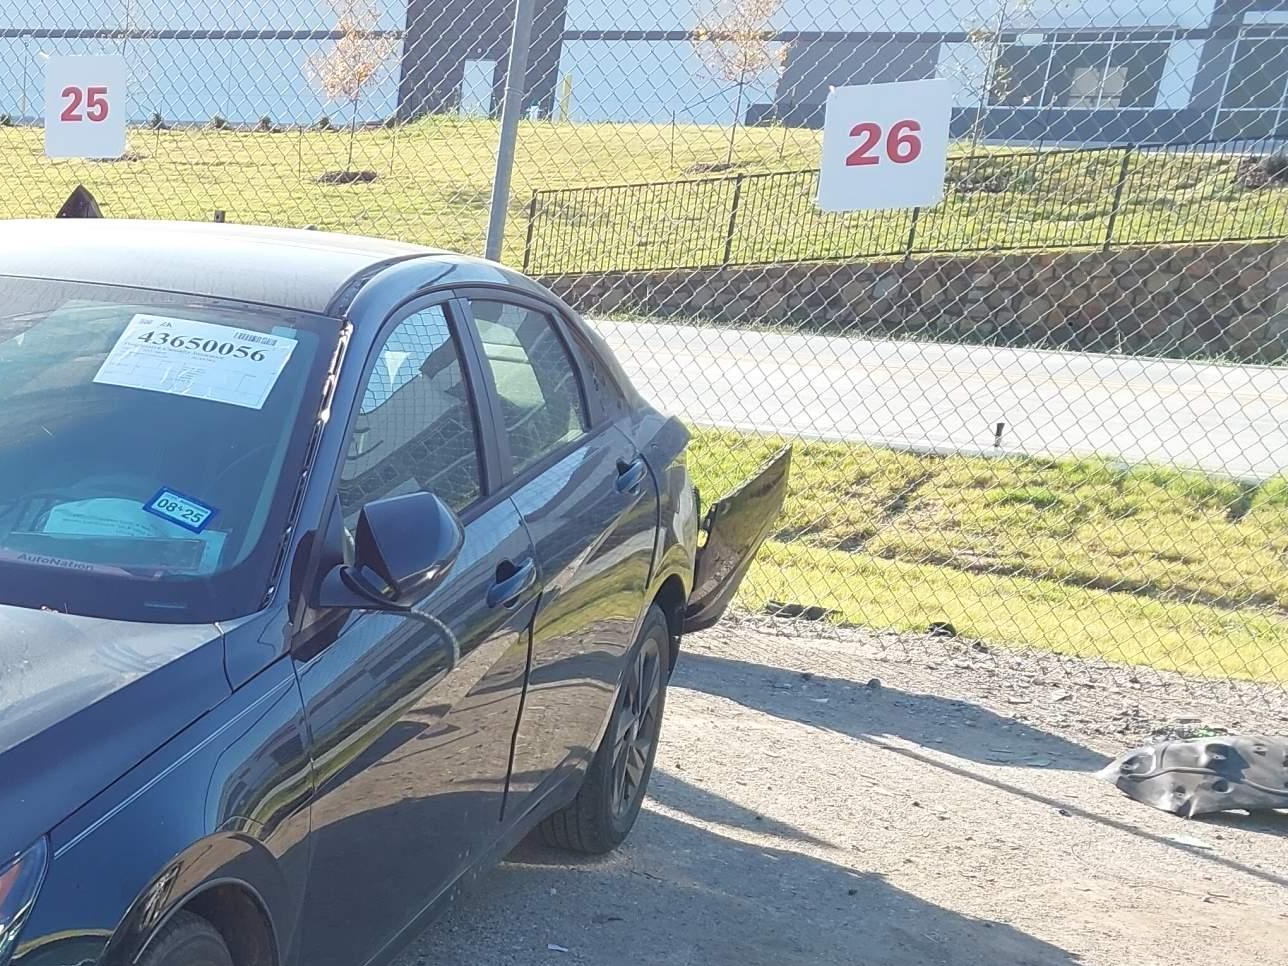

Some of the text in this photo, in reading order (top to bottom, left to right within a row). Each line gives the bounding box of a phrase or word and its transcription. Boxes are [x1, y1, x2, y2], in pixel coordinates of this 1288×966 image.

[60, 87, 109, 121] 25
[845, 119, 922, 166] 26
[137, 330, 266, 362] 43650056
[17, 553, 94, 571] AutoNation
